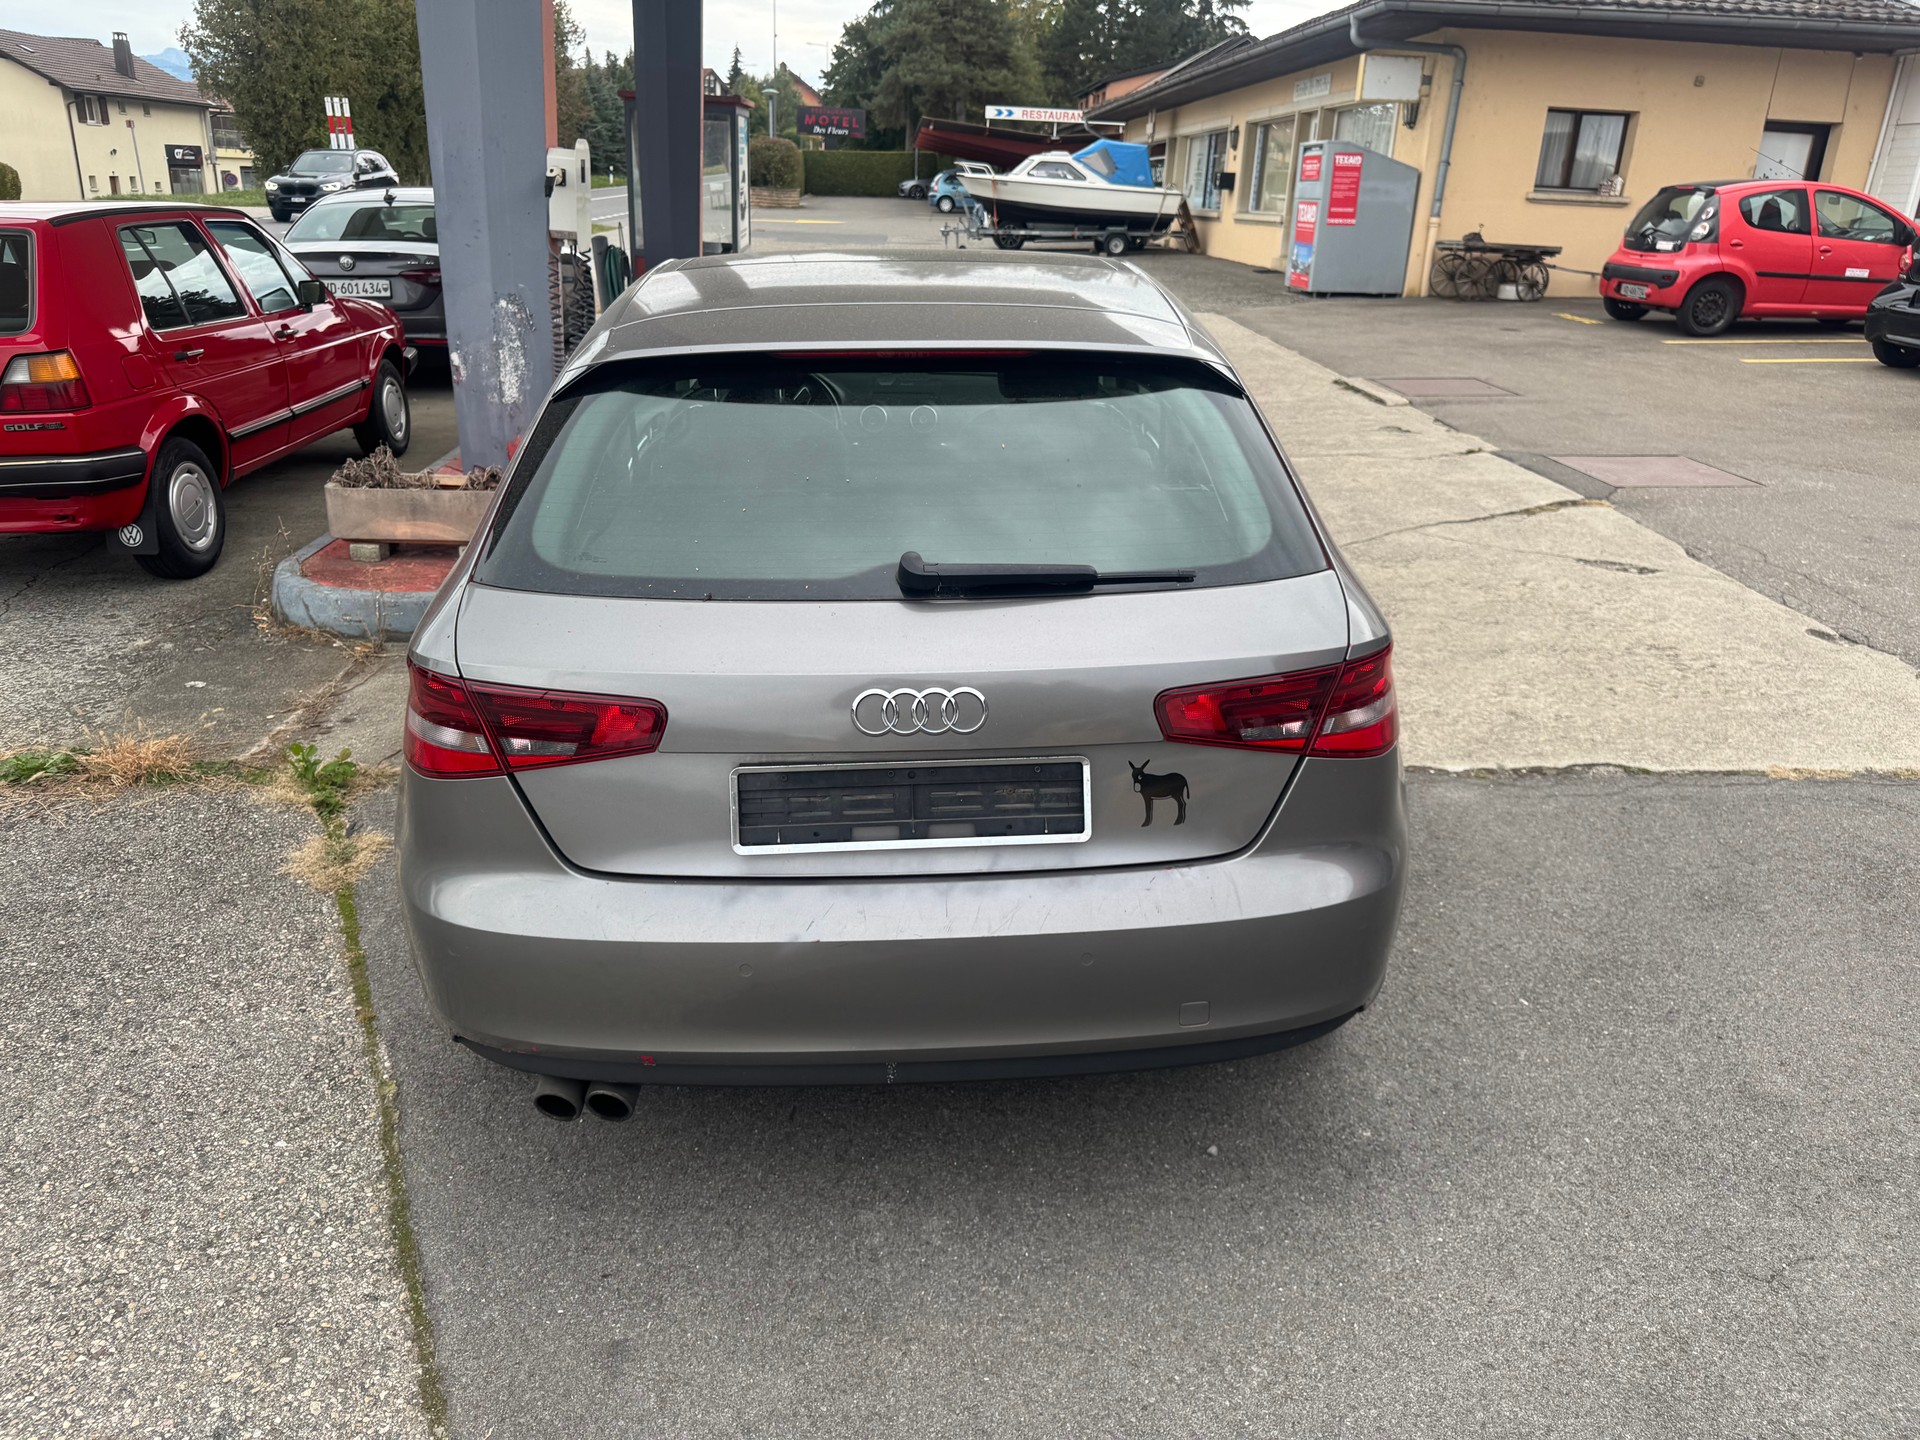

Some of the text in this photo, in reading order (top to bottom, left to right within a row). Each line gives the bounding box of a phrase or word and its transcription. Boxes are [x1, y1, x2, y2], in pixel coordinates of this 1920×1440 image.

[804, 114, 859, 128] MOTEL
[813, 125, 849, 136] Des Fleurs
[1335, 154, 1362, 165] TEXAID
[3, 423, 43, 432] GOLF
